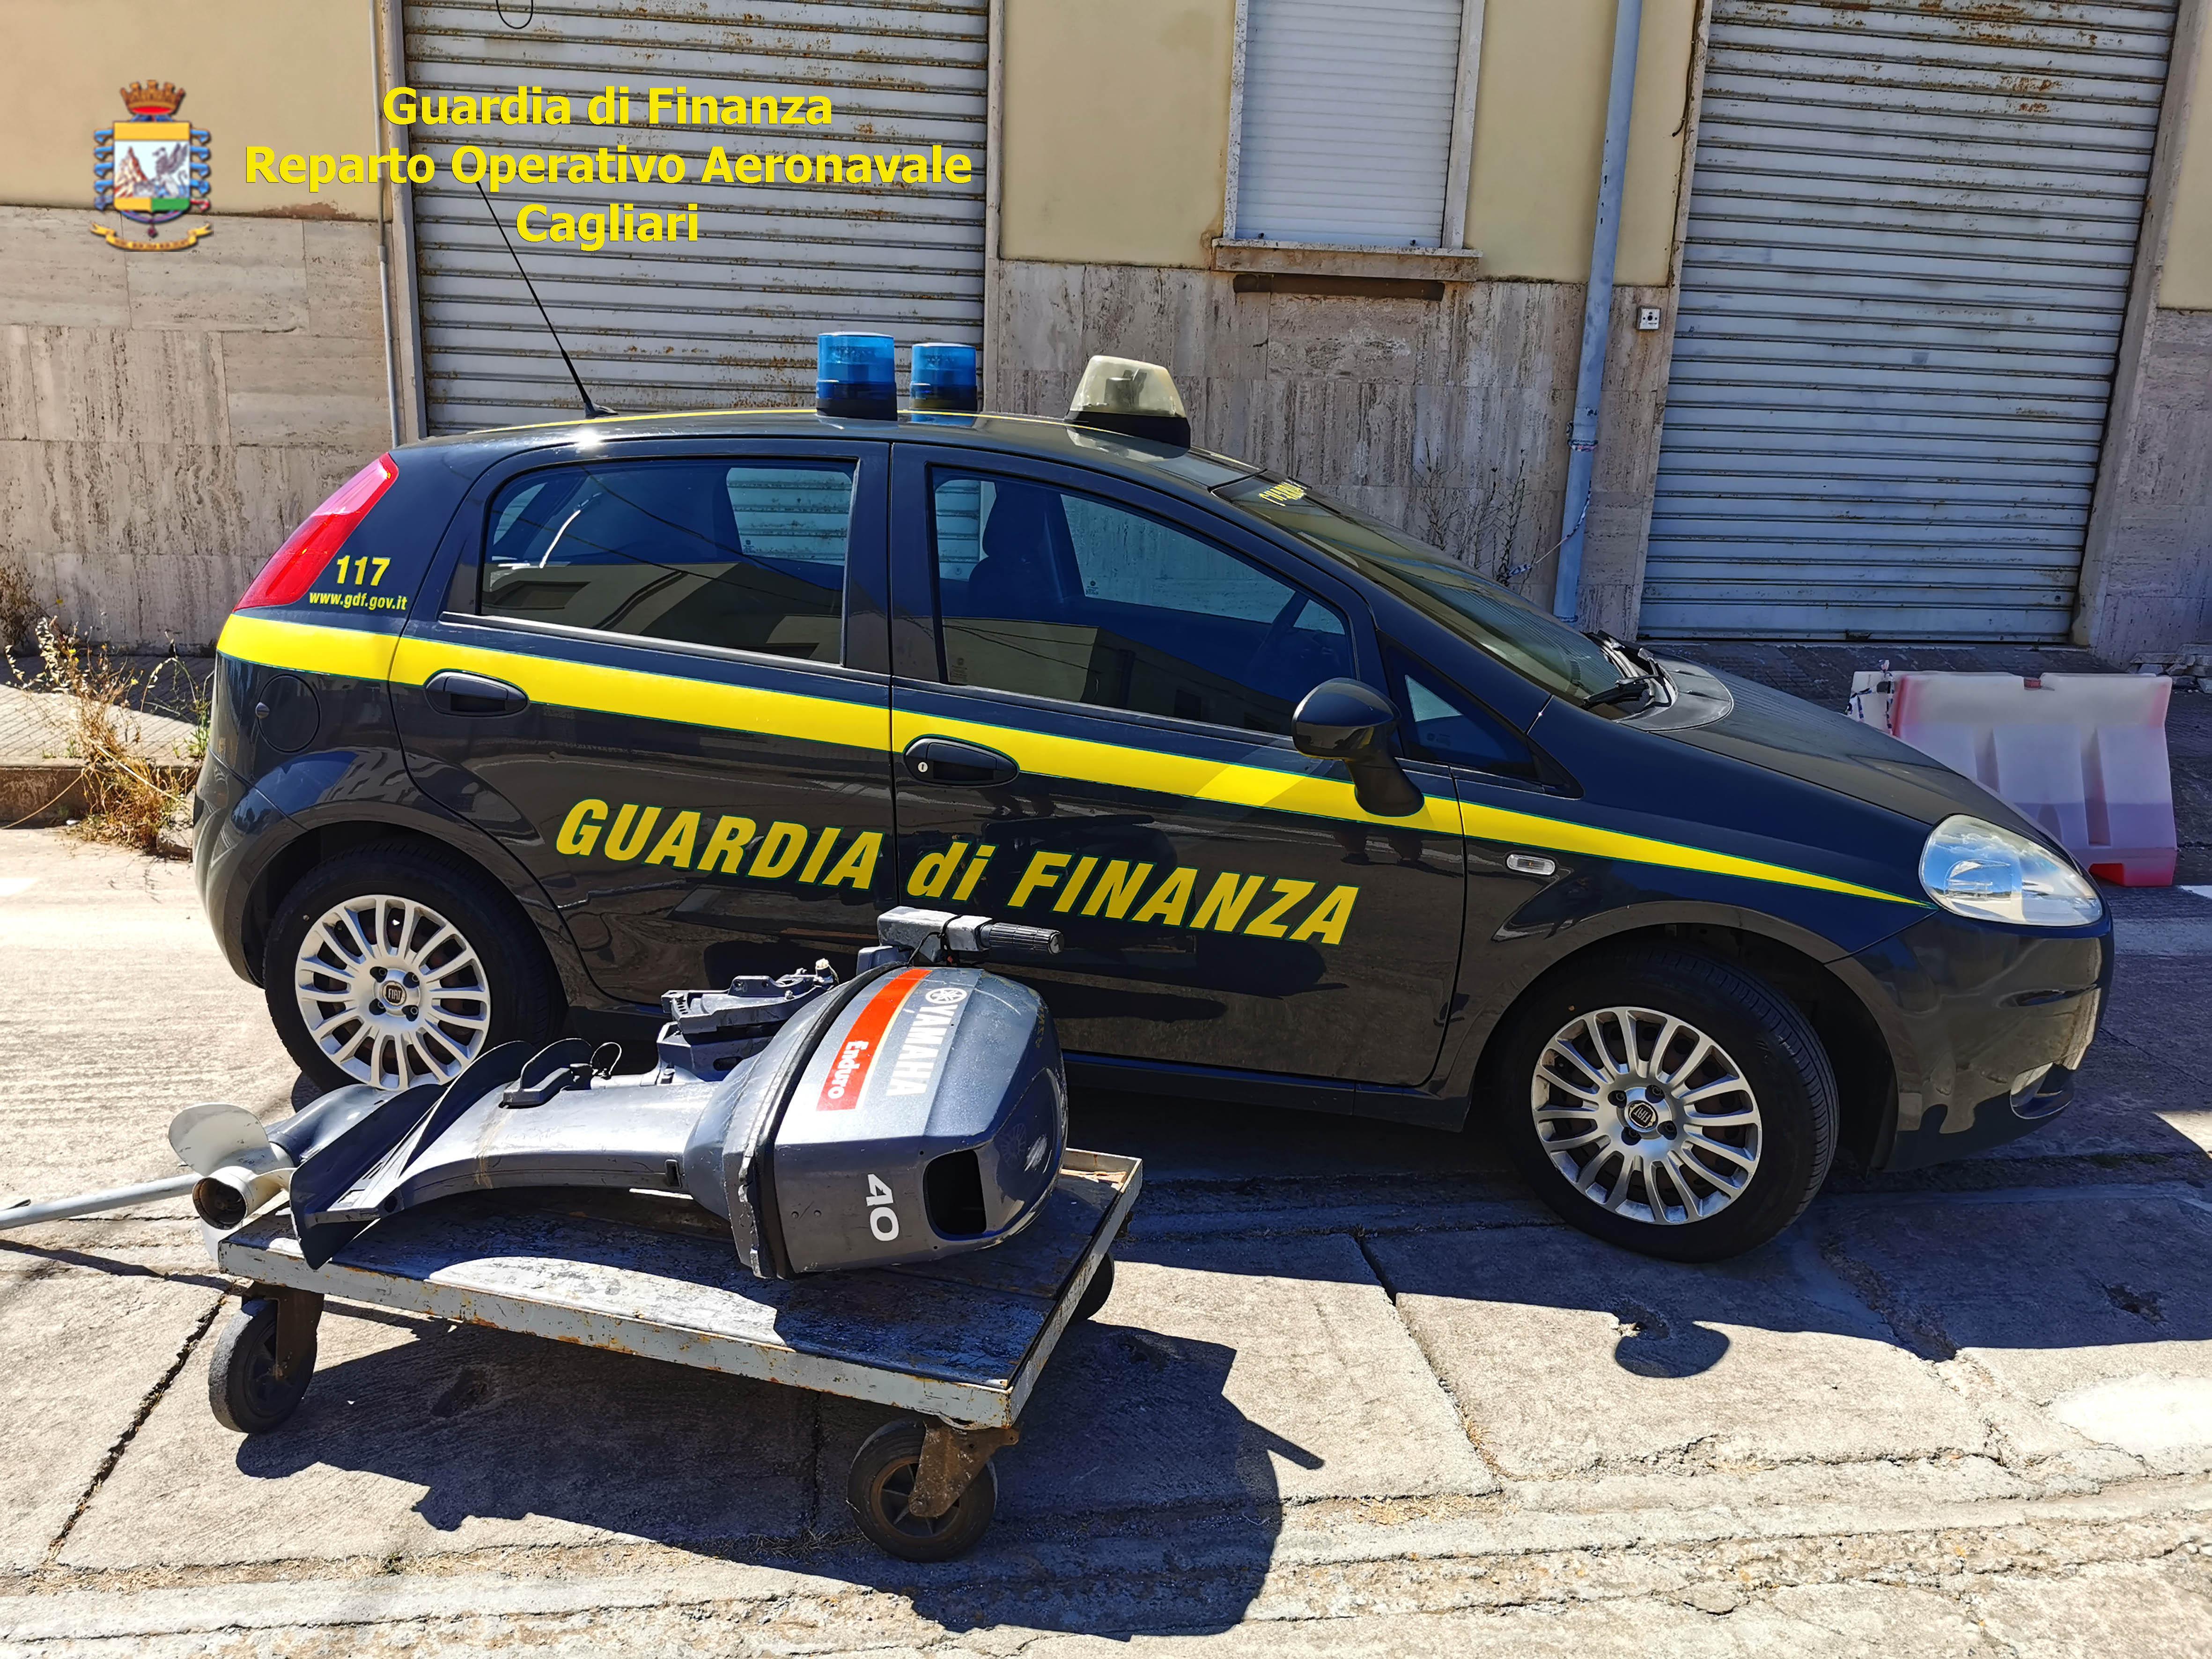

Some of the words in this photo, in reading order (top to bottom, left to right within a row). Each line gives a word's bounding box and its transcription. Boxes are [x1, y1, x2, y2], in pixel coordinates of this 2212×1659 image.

[336, 555, 391, 586] 117
[309, 592, 407, 611] www.gdf.gov.it
[556, 798, 884, 890] GUARDIA
[907, 842, 996, 901] di
[1007, 850, 1360, 945] FINANZA
[388, 988, 401, 1000] FIAT
[827, 1040, 869, 1099] Enduro
[886, 1004, 959, 1096] YAMAHA
[1633, 1106, 1652, 1123] FIAT
[866, 1173, 900, 1241] 40
